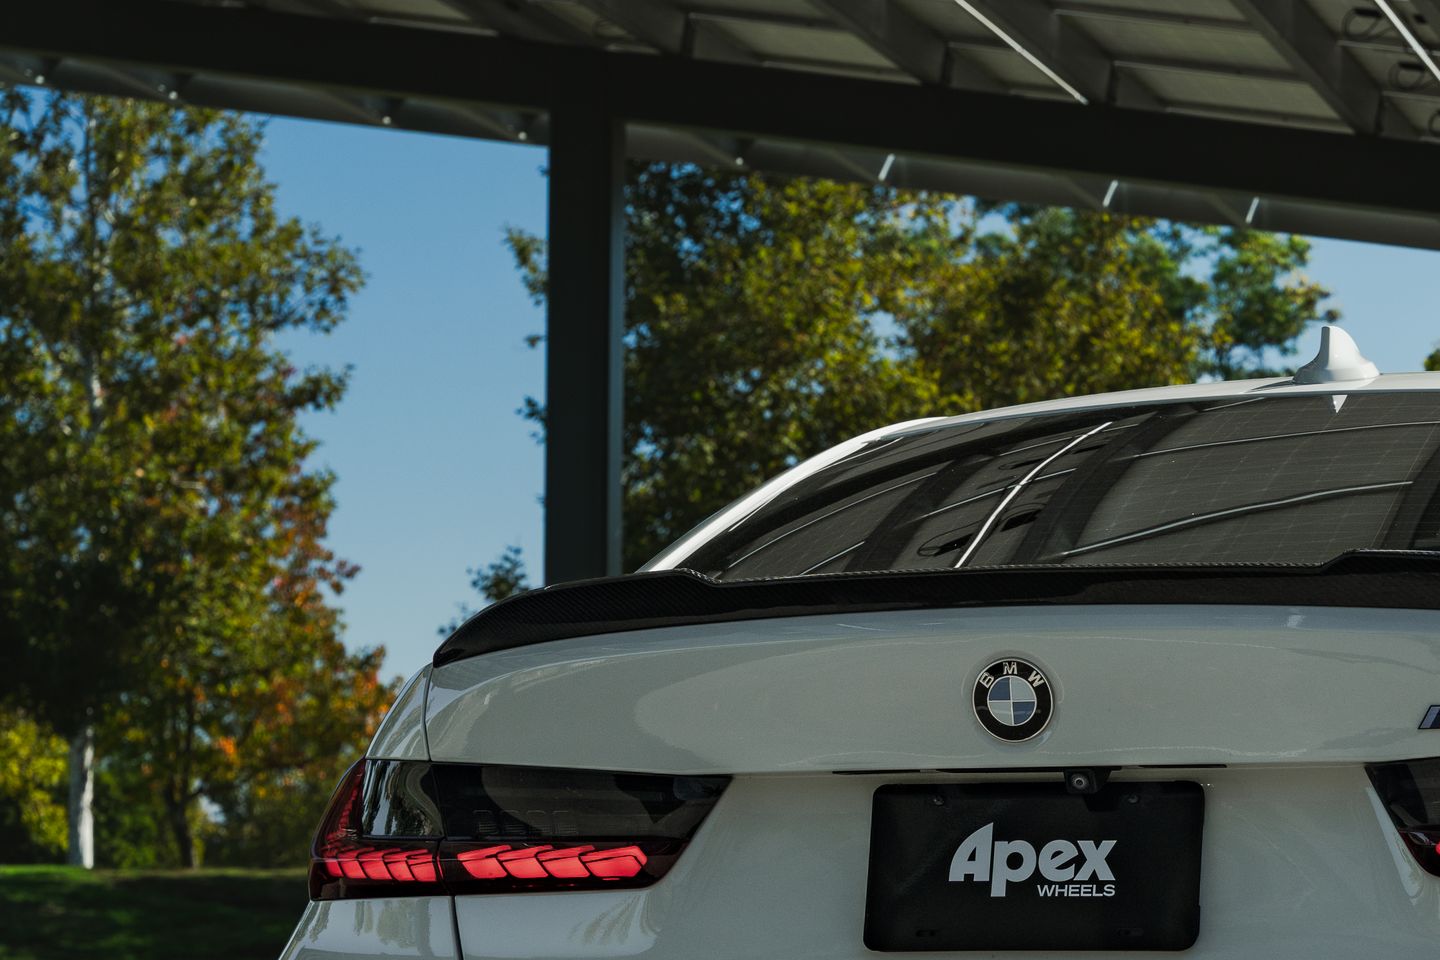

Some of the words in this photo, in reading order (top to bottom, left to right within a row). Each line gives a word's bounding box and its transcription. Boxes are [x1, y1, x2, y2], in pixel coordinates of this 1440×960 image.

[979, 661, 1045, 689] BMW
[949, 822, 1118, 897] Apex
[1037, 884, 1116, 898] WHEELS
